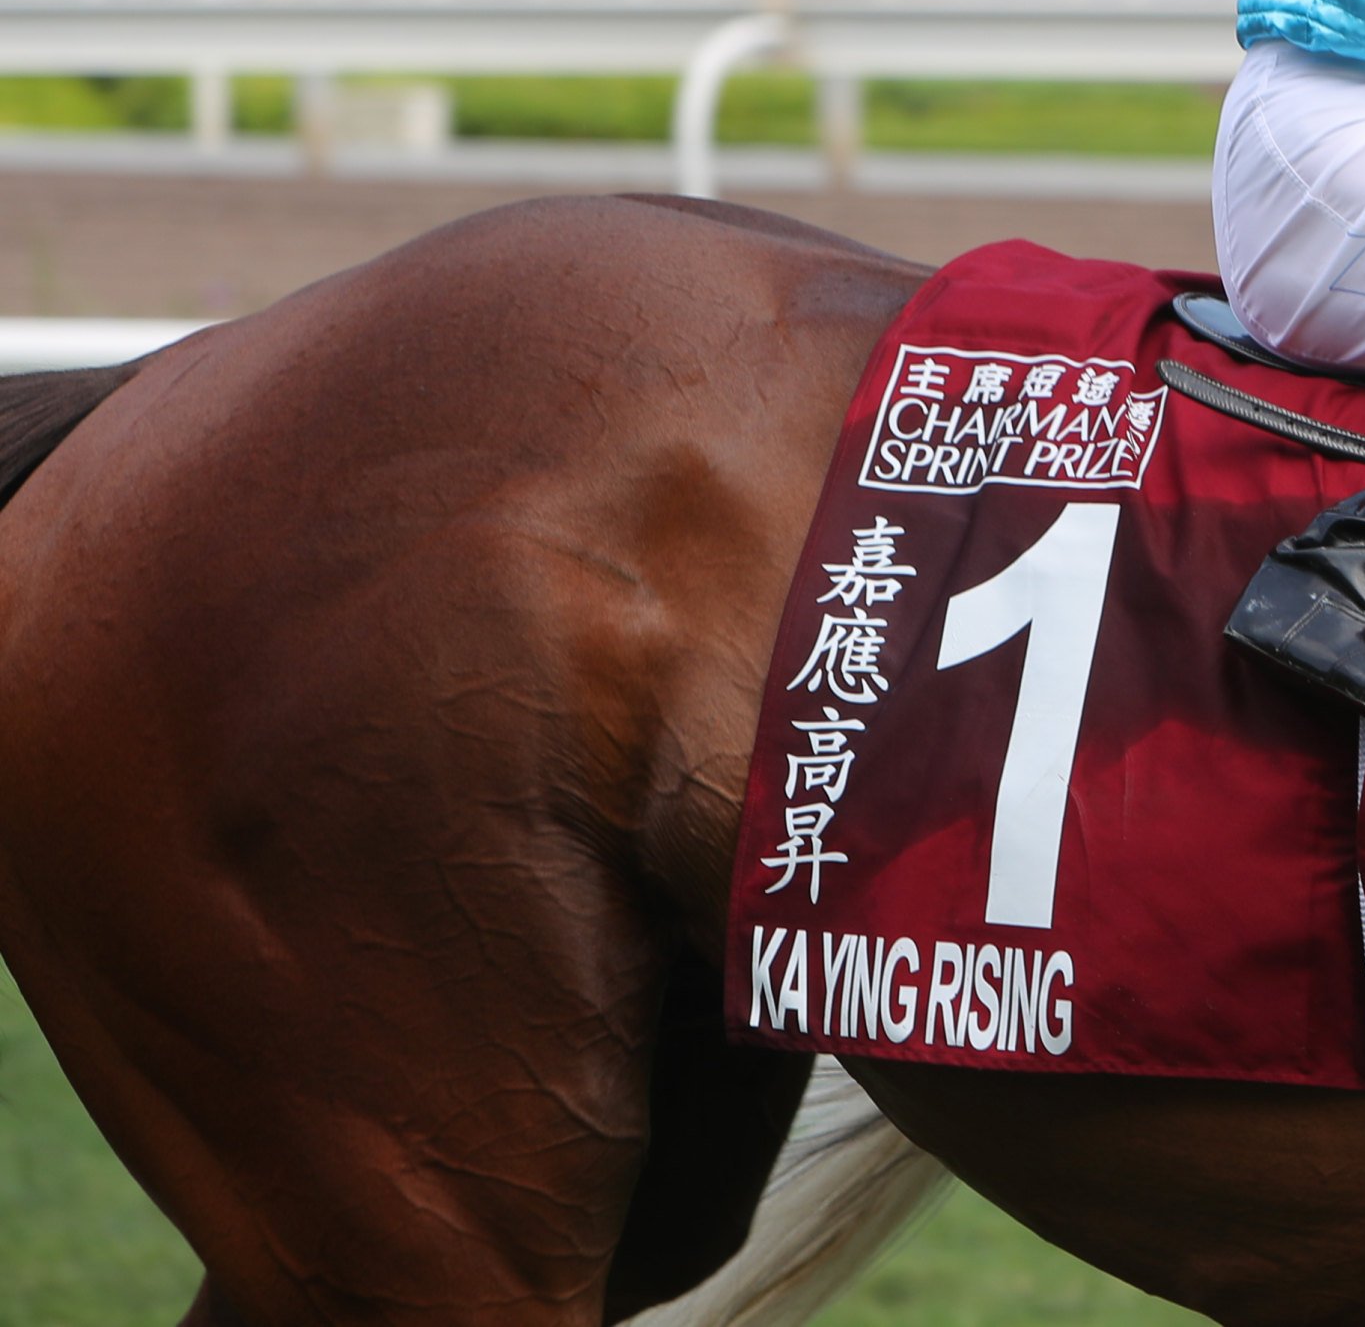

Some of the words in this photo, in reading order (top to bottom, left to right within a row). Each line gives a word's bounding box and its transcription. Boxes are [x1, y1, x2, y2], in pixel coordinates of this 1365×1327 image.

[874, 436, 1023, 485] SPRINT
[1023, 438, 1138, 480] PRIZE
[760, 515, 918, 905] 嘉應高昇
[936, 502, 1121, 929] 1
[750, 925, 808, 1034] KA
[823, 931, 920, 1043] YING
[925, 940, 1074, 1055] RISING
